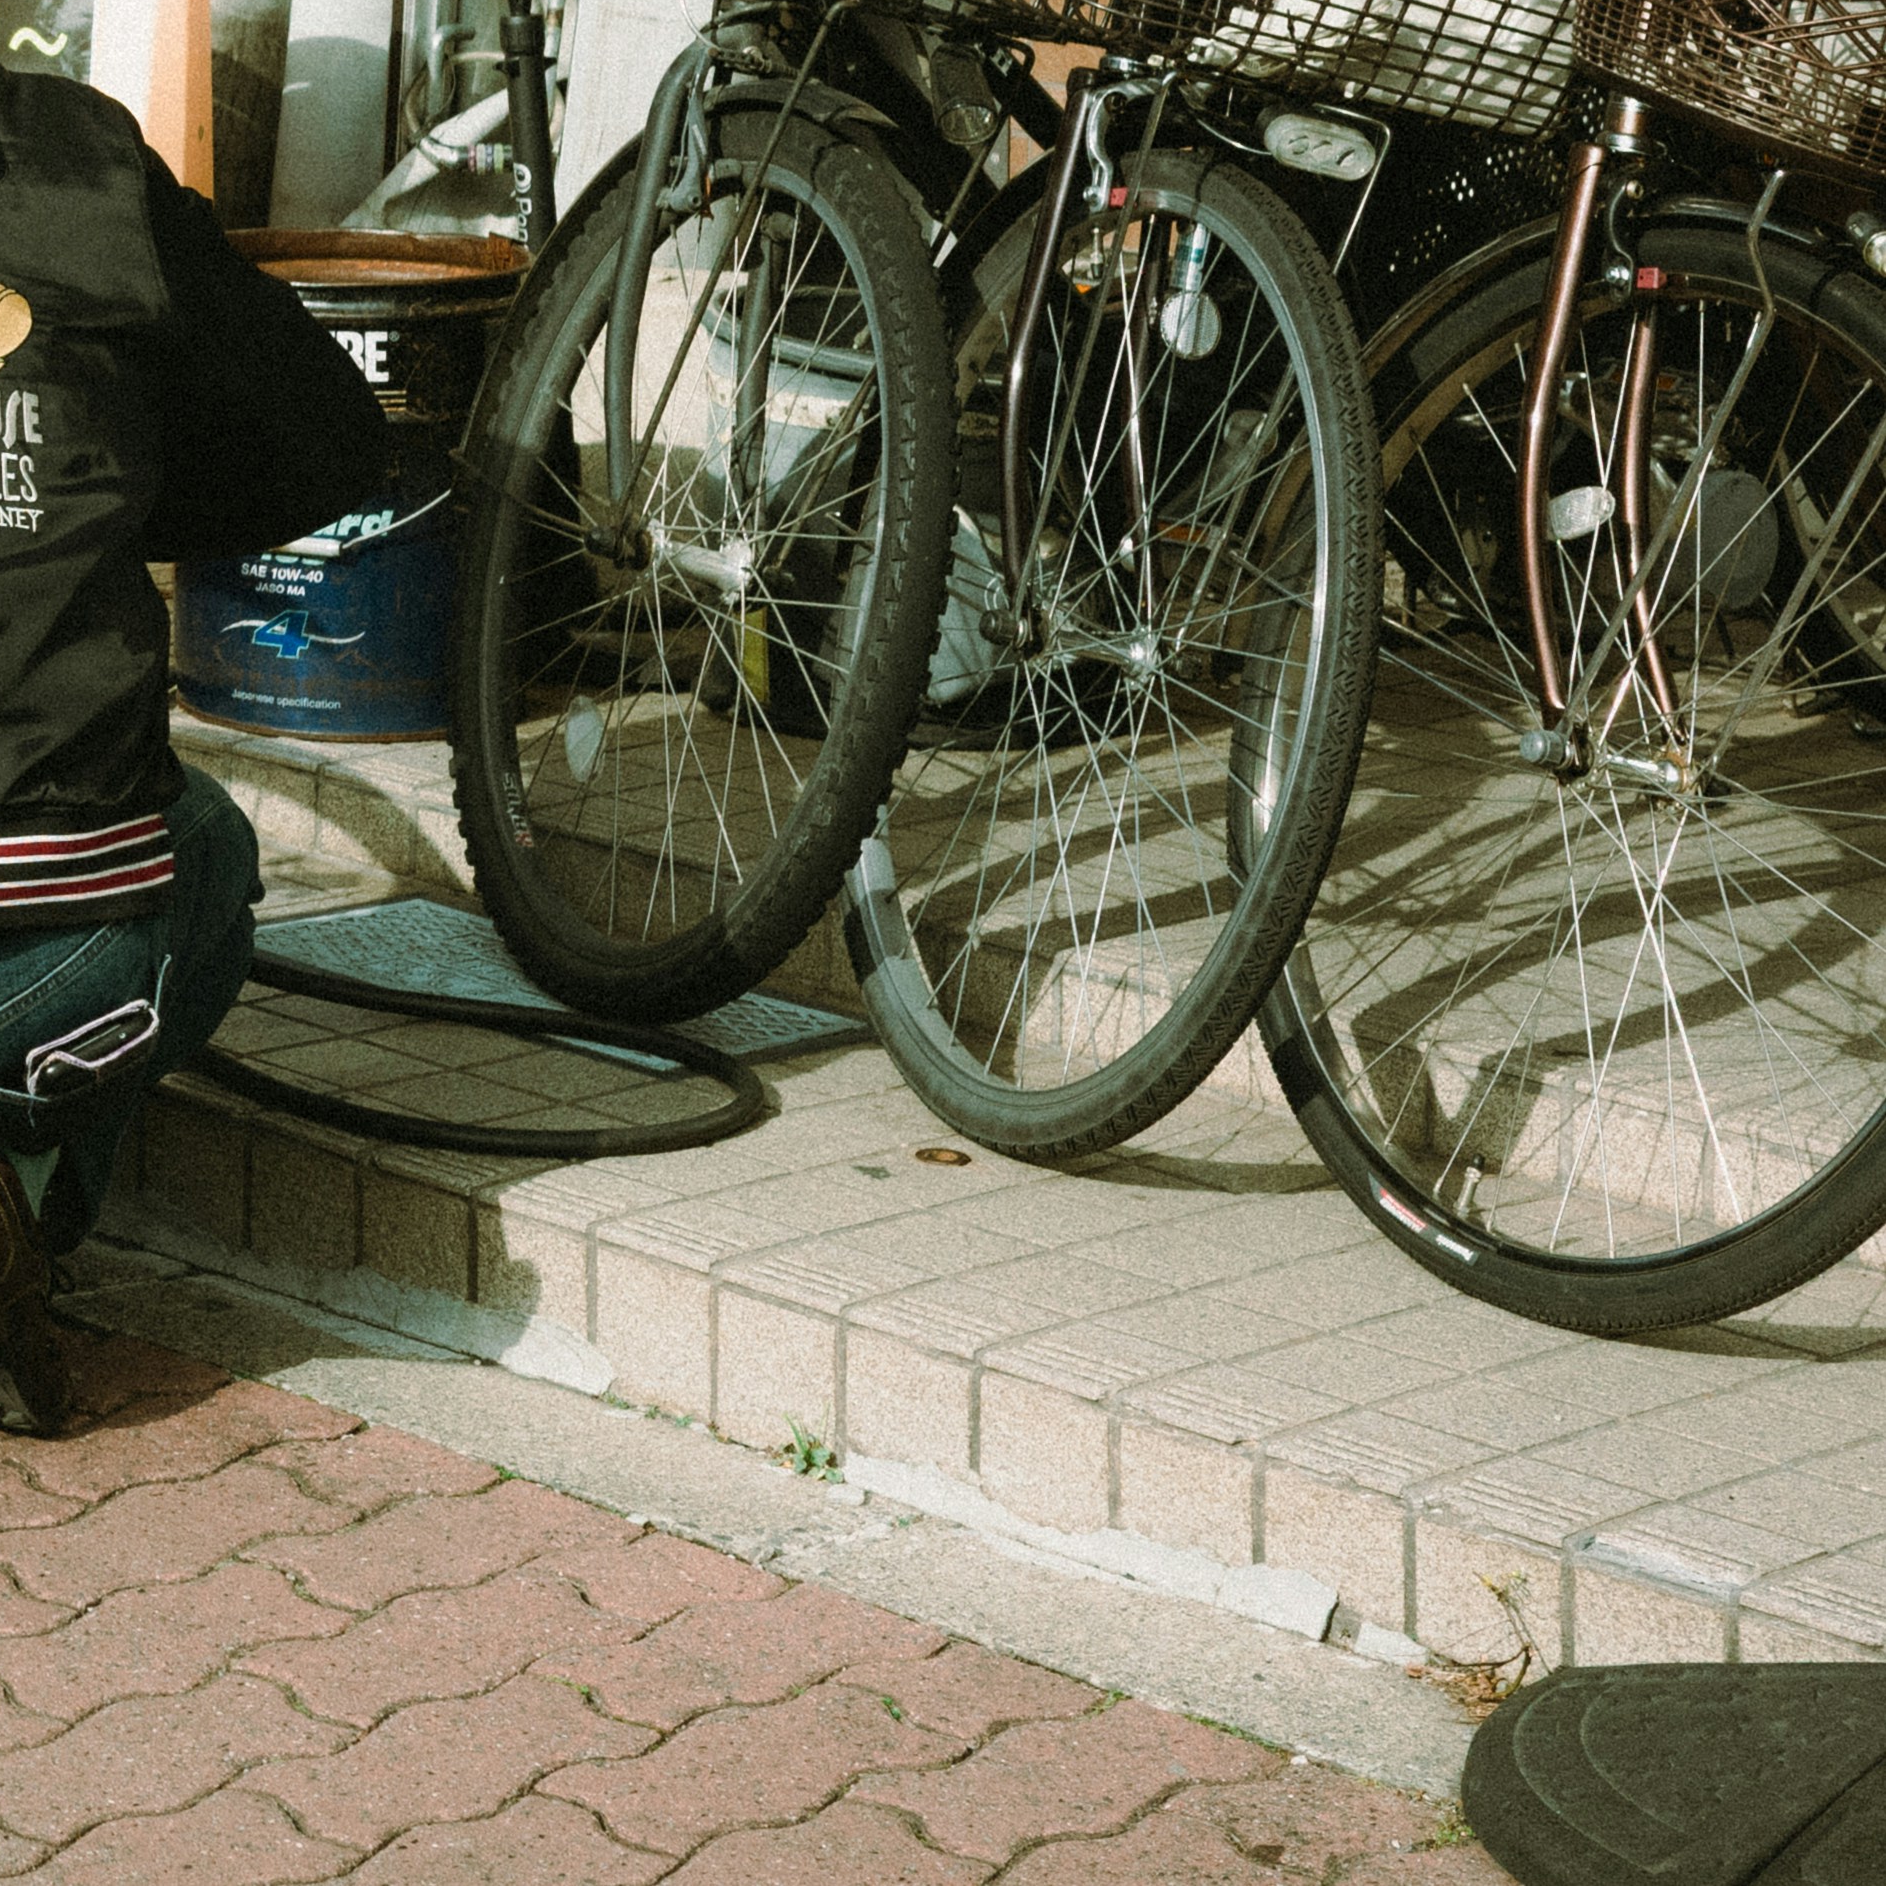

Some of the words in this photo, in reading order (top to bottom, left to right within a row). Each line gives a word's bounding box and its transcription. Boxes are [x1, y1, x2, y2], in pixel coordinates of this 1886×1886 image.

[515, 197, 533, 251] Pan
[241, 563, 268, 578] SAE
[271, 567, 324, 583] 10W-40
[255, 582, 285, 594] JASO
[286, 585, 306, 597] MA
[251, 609, 312, 660] 4
[231, 689, 275, 705] Japanese
[277, 695, 341, 710] specification
